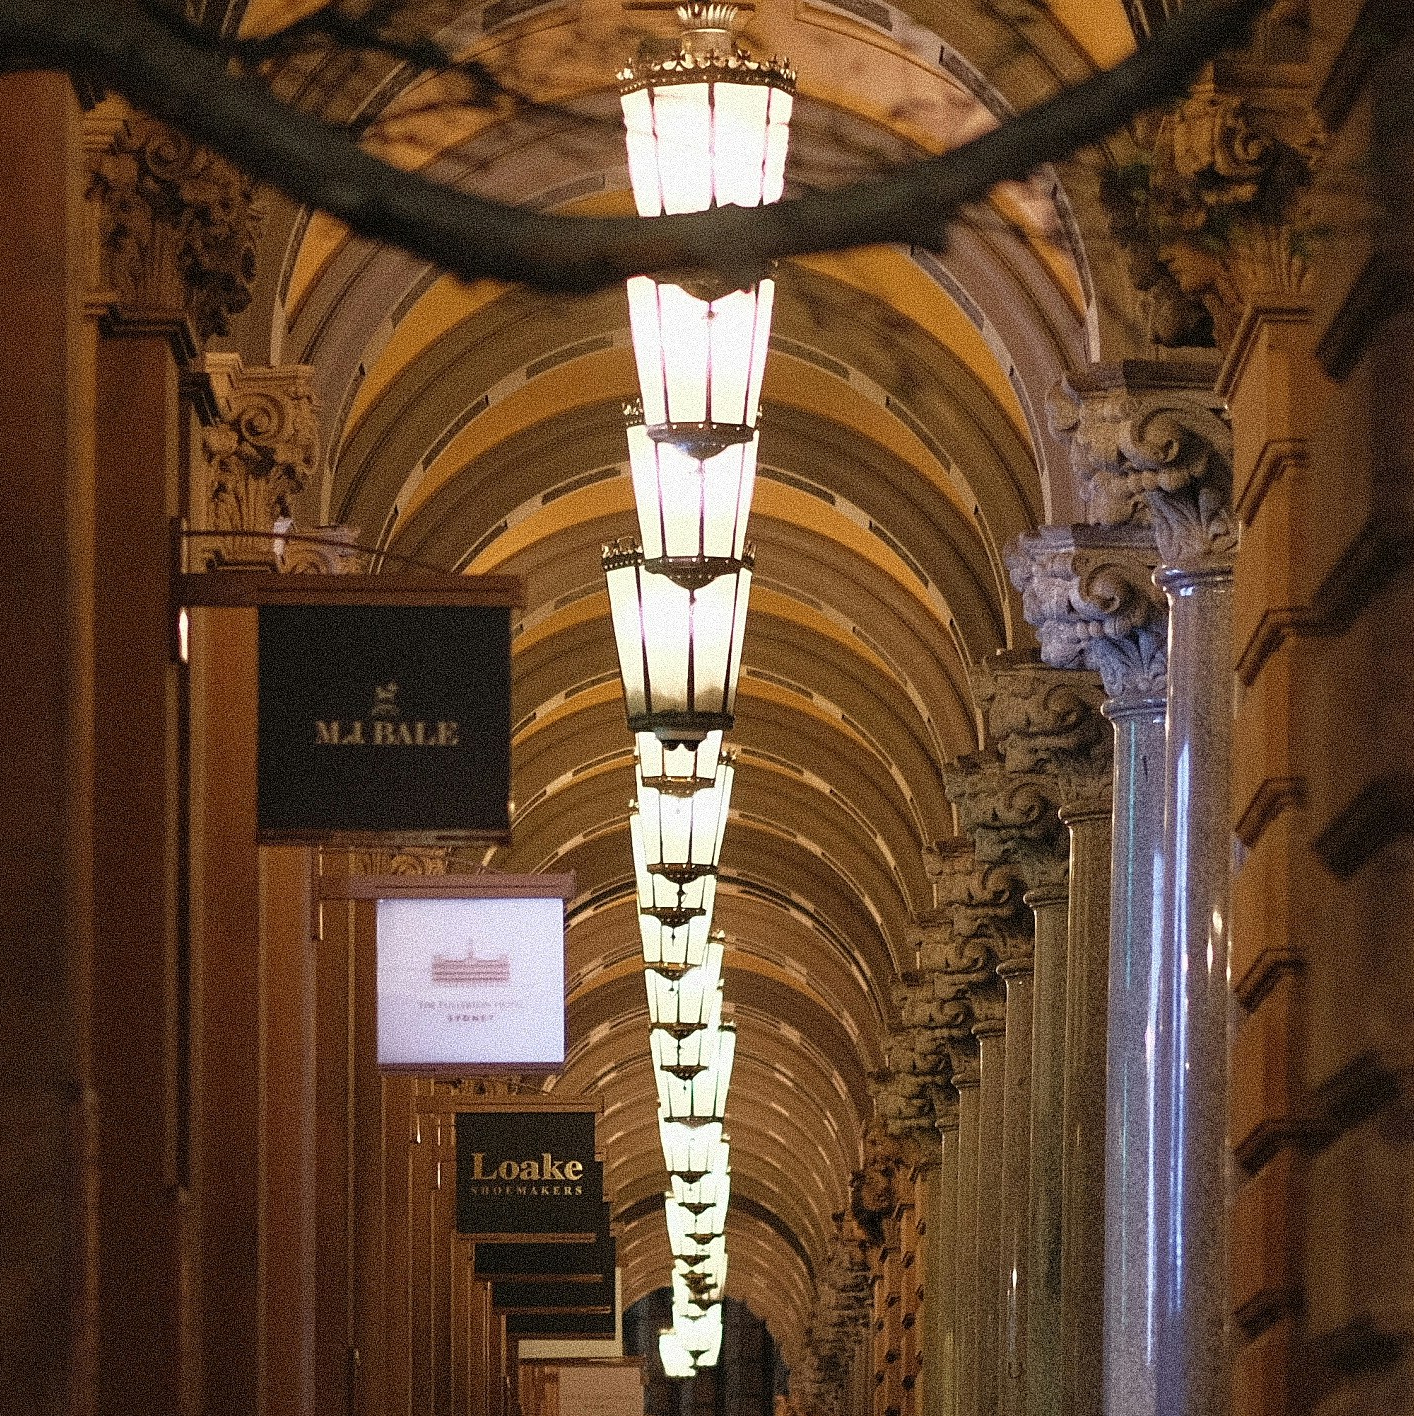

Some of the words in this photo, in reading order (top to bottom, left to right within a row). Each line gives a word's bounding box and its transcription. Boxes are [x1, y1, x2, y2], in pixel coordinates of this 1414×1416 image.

[373, 720, 459, 745] BALE
[470, 1152, 584, 1181] Loake
[470, 1185, 583, 1196] SHOEMAKERS
